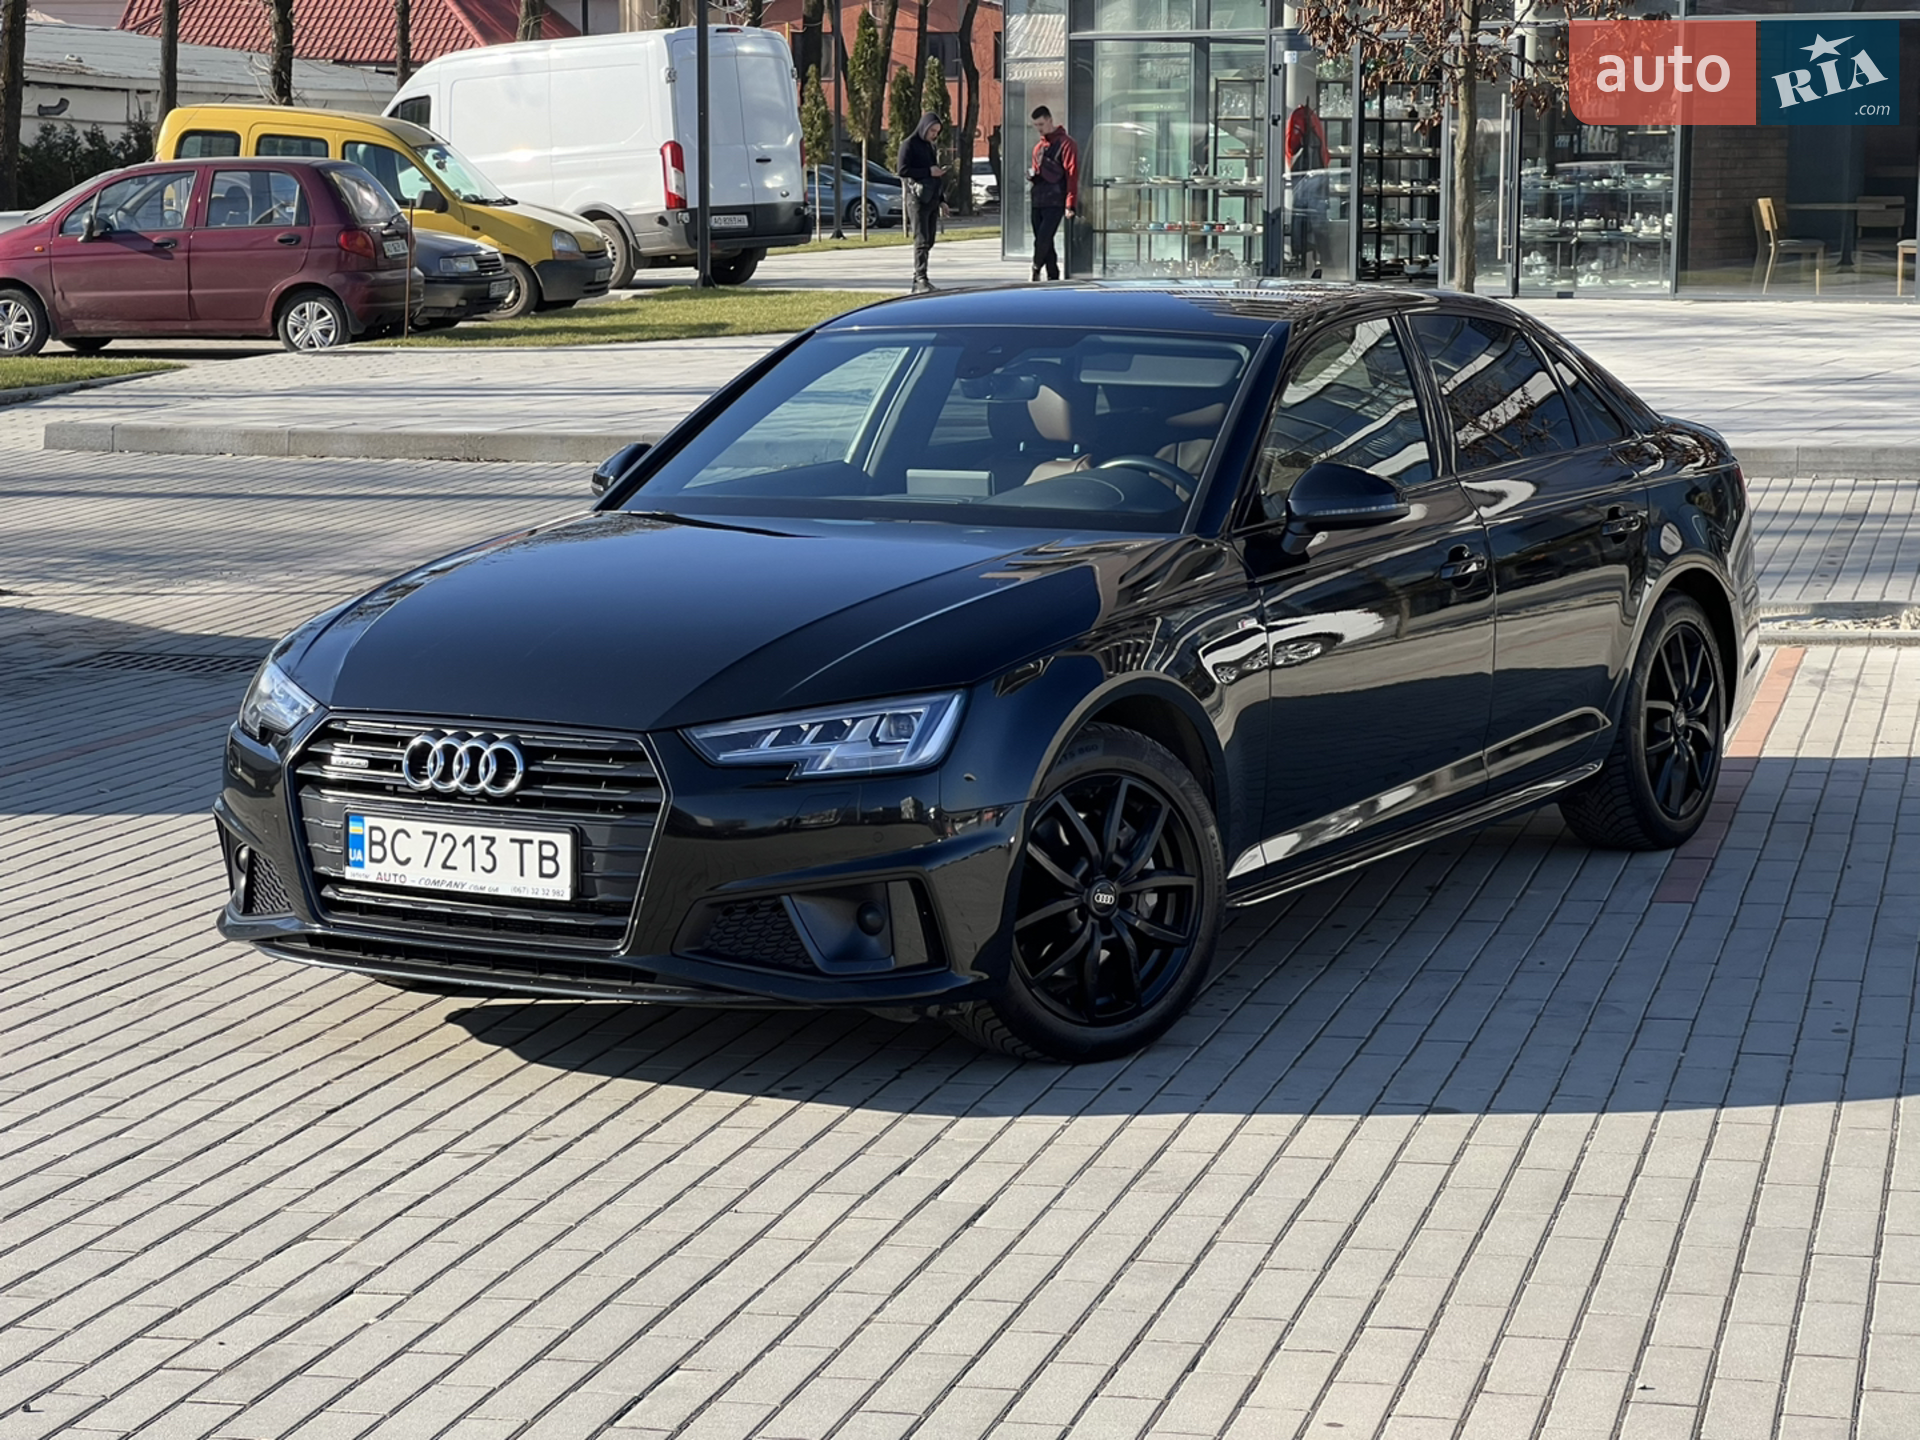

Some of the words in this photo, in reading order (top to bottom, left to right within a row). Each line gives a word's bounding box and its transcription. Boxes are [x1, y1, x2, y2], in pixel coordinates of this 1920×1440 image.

[349, 848, 363, 862] UA
[368, 825, 412, 866] BC
[421, 830, 498, 874] 7213
[509, 838, 561, 879] TB
[375, 871, 408, 884] AUTO
[418, 877, 467, 890] COMPANY
